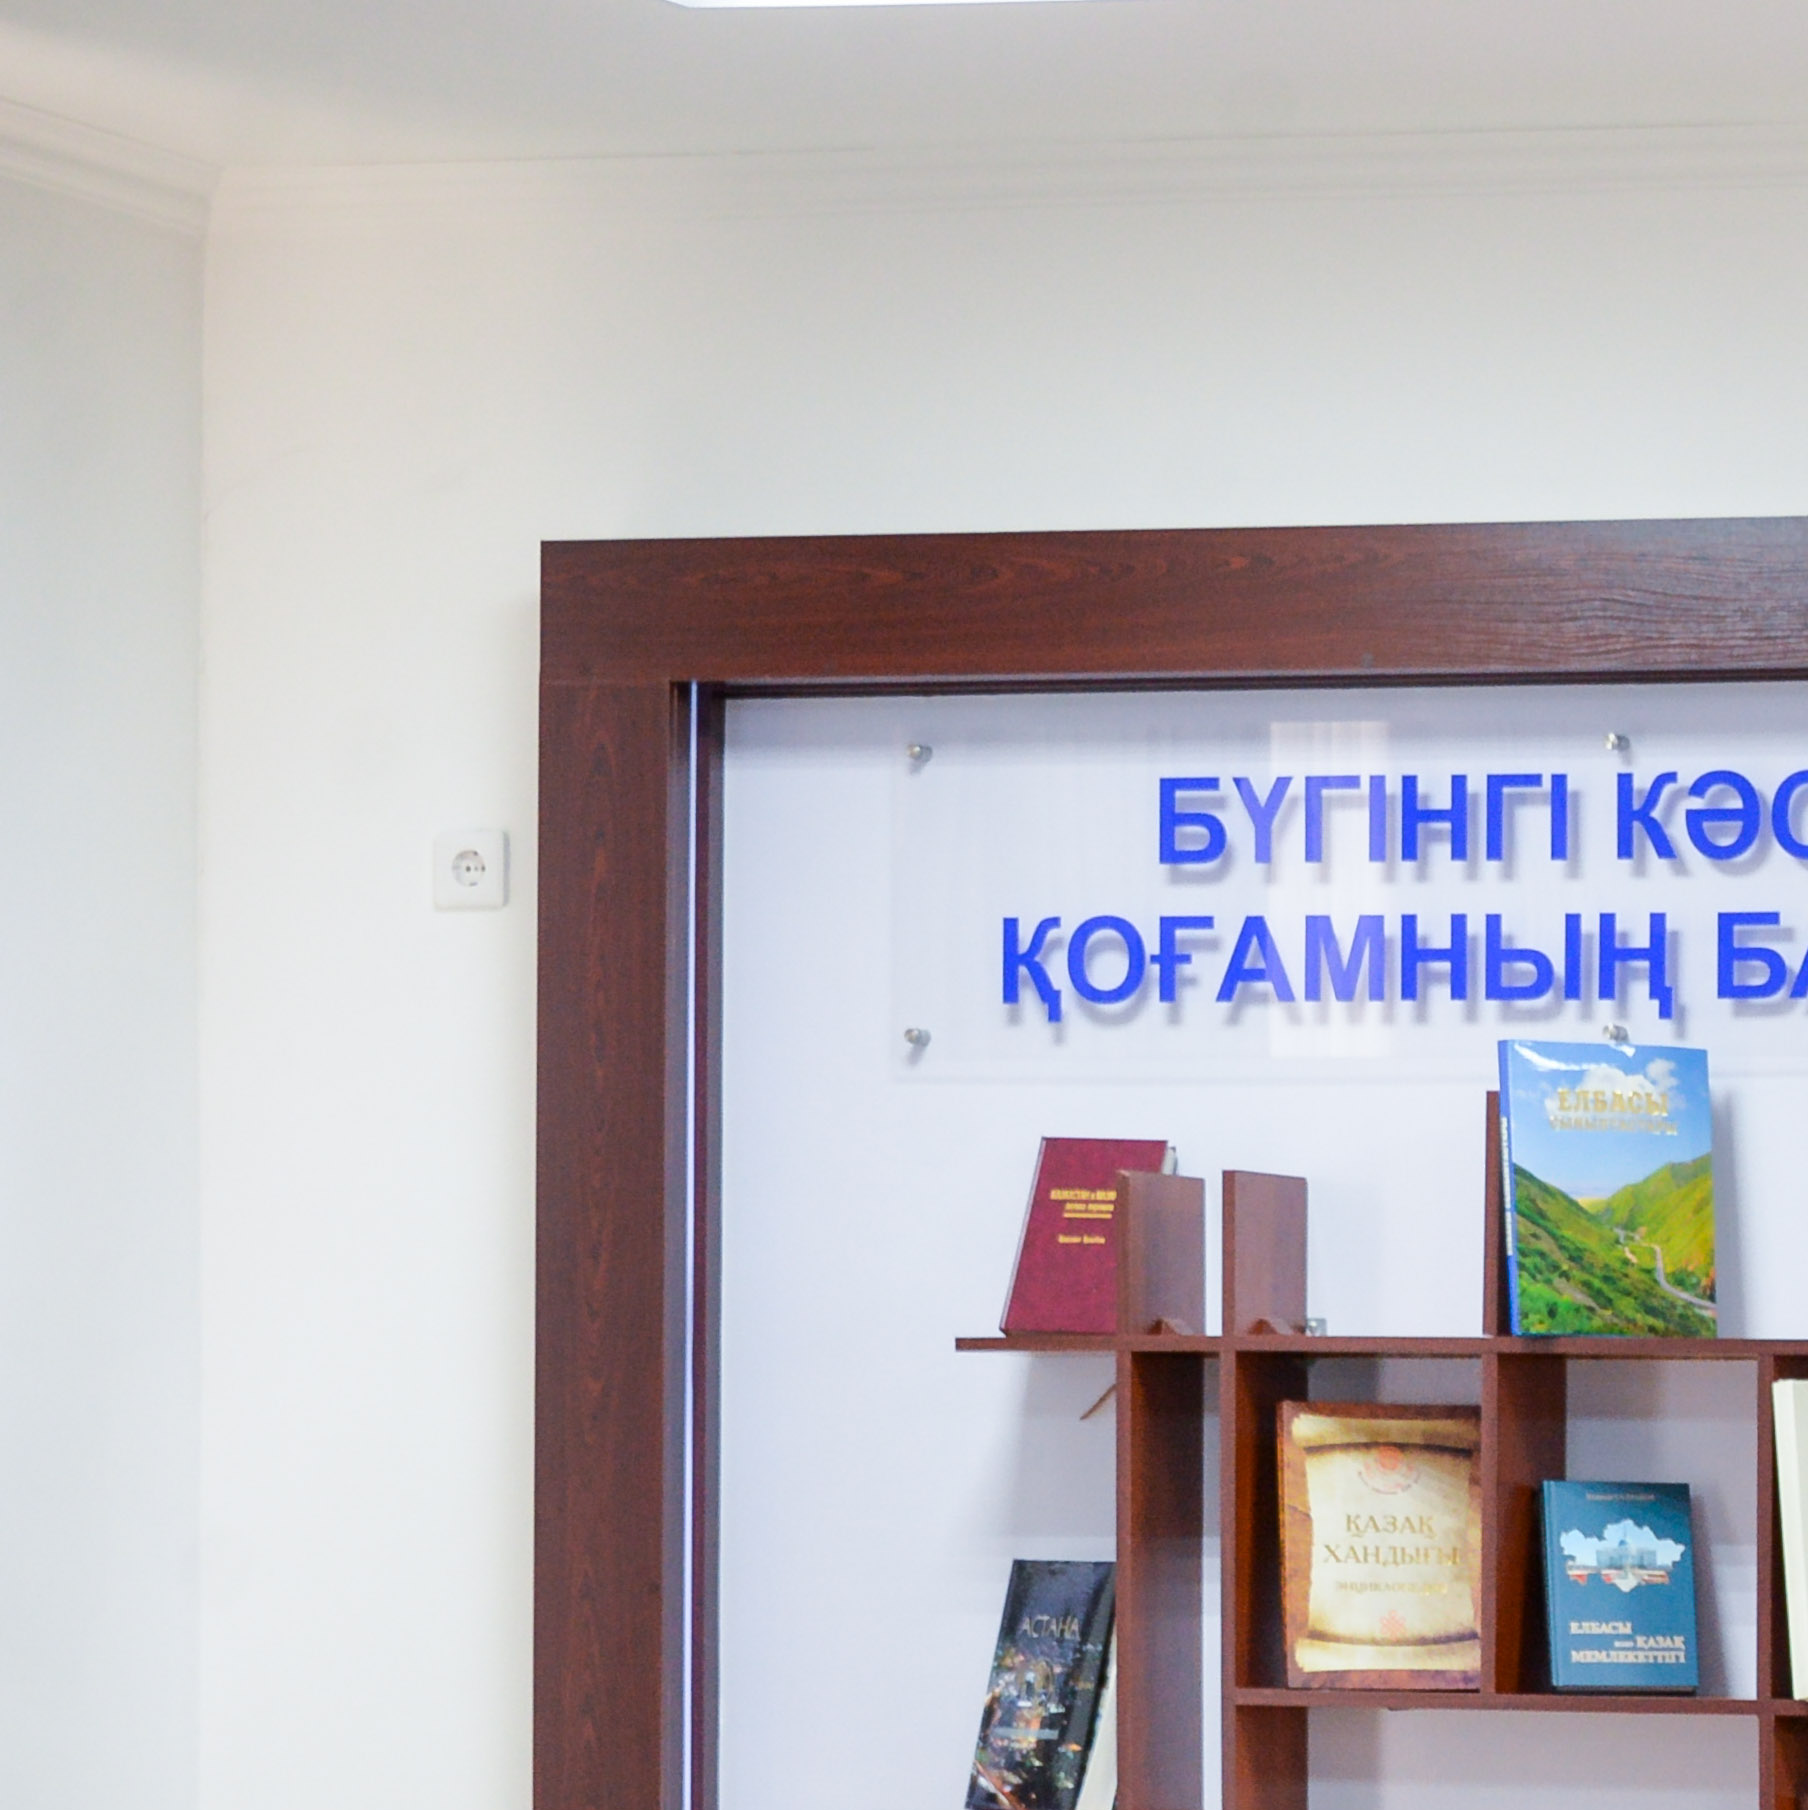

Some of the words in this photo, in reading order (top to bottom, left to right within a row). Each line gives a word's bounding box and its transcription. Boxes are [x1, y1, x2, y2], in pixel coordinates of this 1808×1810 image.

[1158, 773, 1571, 866] БҮГІНГІ
[1001, 912, 1676, 1021] ҚОҒАМНЫҢ
[1558, 1088, 1669, 1117] ЕЛБАСЫ
[1345, 1514, 1436, 1538] ҚАЗАҚ
[1020, 1615, 1082, 1640] АСТАНА
